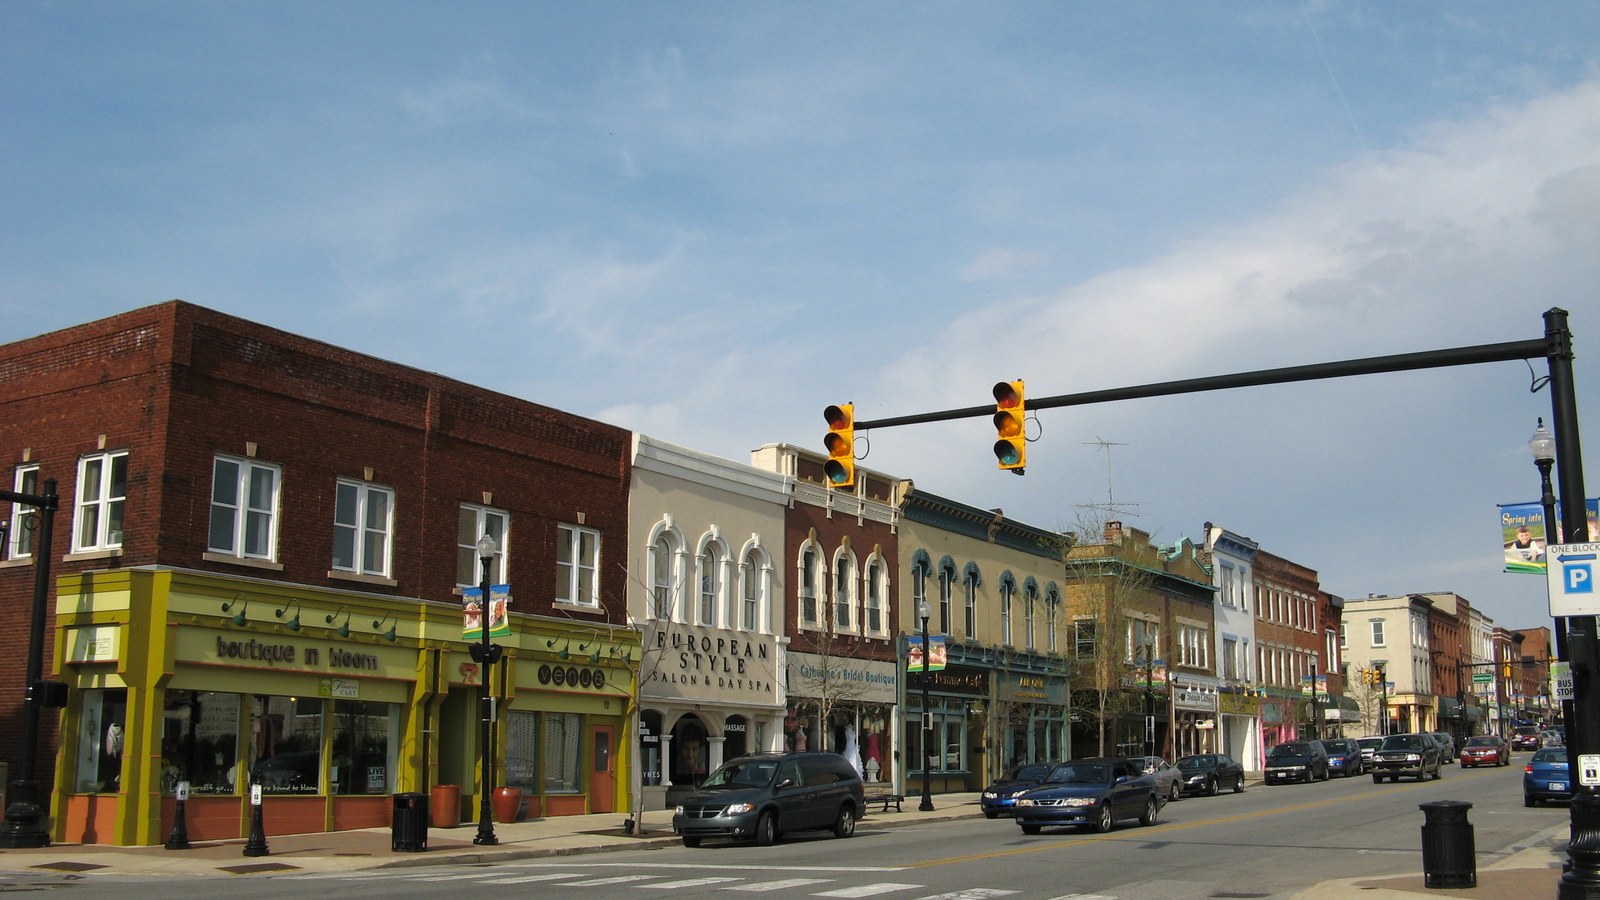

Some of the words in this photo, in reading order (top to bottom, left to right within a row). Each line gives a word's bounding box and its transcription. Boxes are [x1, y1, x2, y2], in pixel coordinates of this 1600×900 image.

[1502, 512, 1526, 526] Spring
[1528, 513, 1542, 522] into
[1551, 545, 1570, 554] ONE
[1573, 544, 1600, 552] BLOCK
[1570, 569, 1588, 588] P
[217, 636, 295, 665] boutique
[304, 648, 319, 665] in
[329, 648, 377, 670] bloom
[657, 631, 767, 659] EUROPEAN
[679, 652, 745, 674] STYLE
[539, 666, 605, 688] venue
[653, 671, 697, 685] SALON
[705, 676, 710, 685] &
[719, 677, 742, 688] DAY
[749, 680, 770, 692] SPA
[800, 664, 840, 681] Cathene's
[843, 669, 864, 682] Bridal
[865, 671, 896, 686] Boutique
[1557, 688, 1574, 696] STOP
[1558, 680, 1572, 688] BUS
[341, 689, 357, 697] CART
[725, 724, 746, 732] MASSAGE
[368, 767, 384, 775] LIVE
